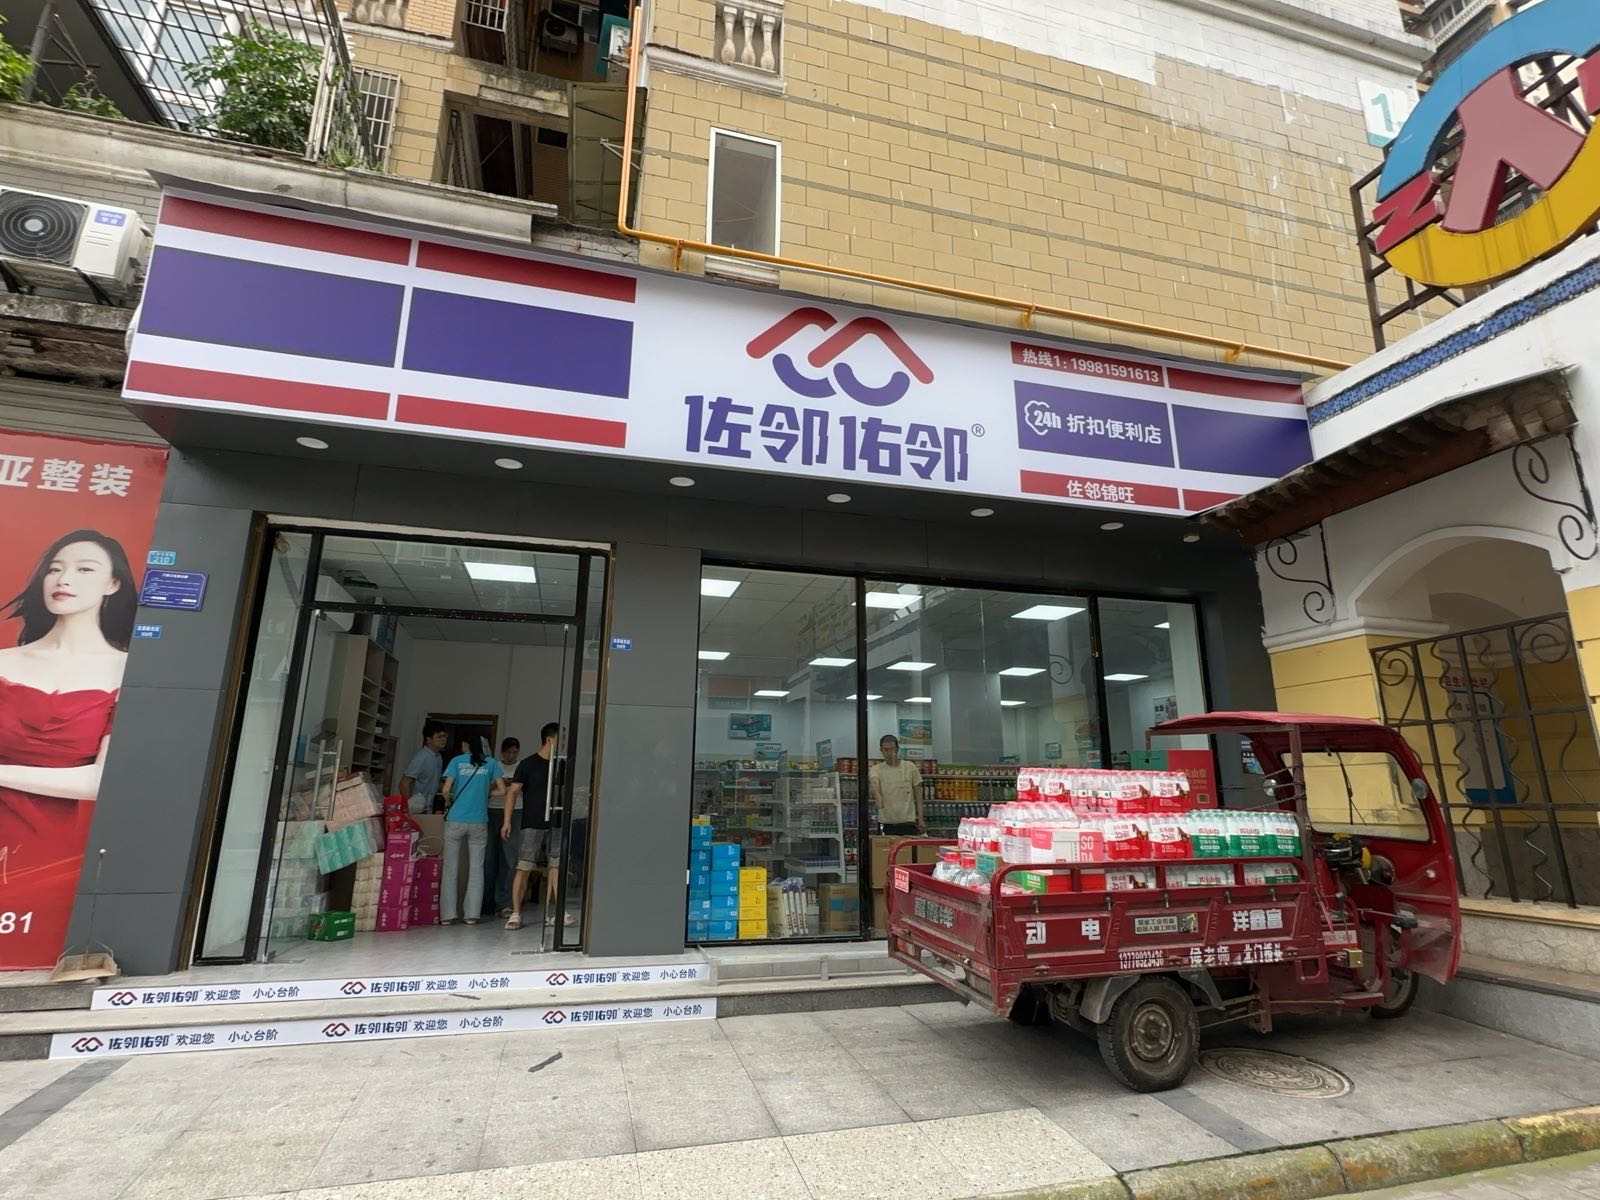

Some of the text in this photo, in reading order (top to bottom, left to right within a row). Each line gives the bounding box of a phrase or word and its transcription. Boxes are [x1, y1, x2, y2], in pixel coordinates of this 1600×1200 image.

[1033, 410, 1162, 445] 24h 折扣便利店
[0, 453, 133, 497] 亚整装
[1067, 480, 1135, 503] 佐邻锦旺
[1080, 836, 1094, 850] SO
[1025, 918, 1101, 945] 动 电
[142, 968, 697, 1004] 佐邻佑邻 欢迎您 小心台阶 佐邻佑邻 欢迎您 小心台阶 佐邻佑邻 欢迎您 小心台阶
[108, 1004, 703, 1050] 佐邻佑邻 欢迎您 小心台阶 佐邻佑邻 欢迎您 小心台阶 佐邻佑邻 欢迎您 小心台阶
